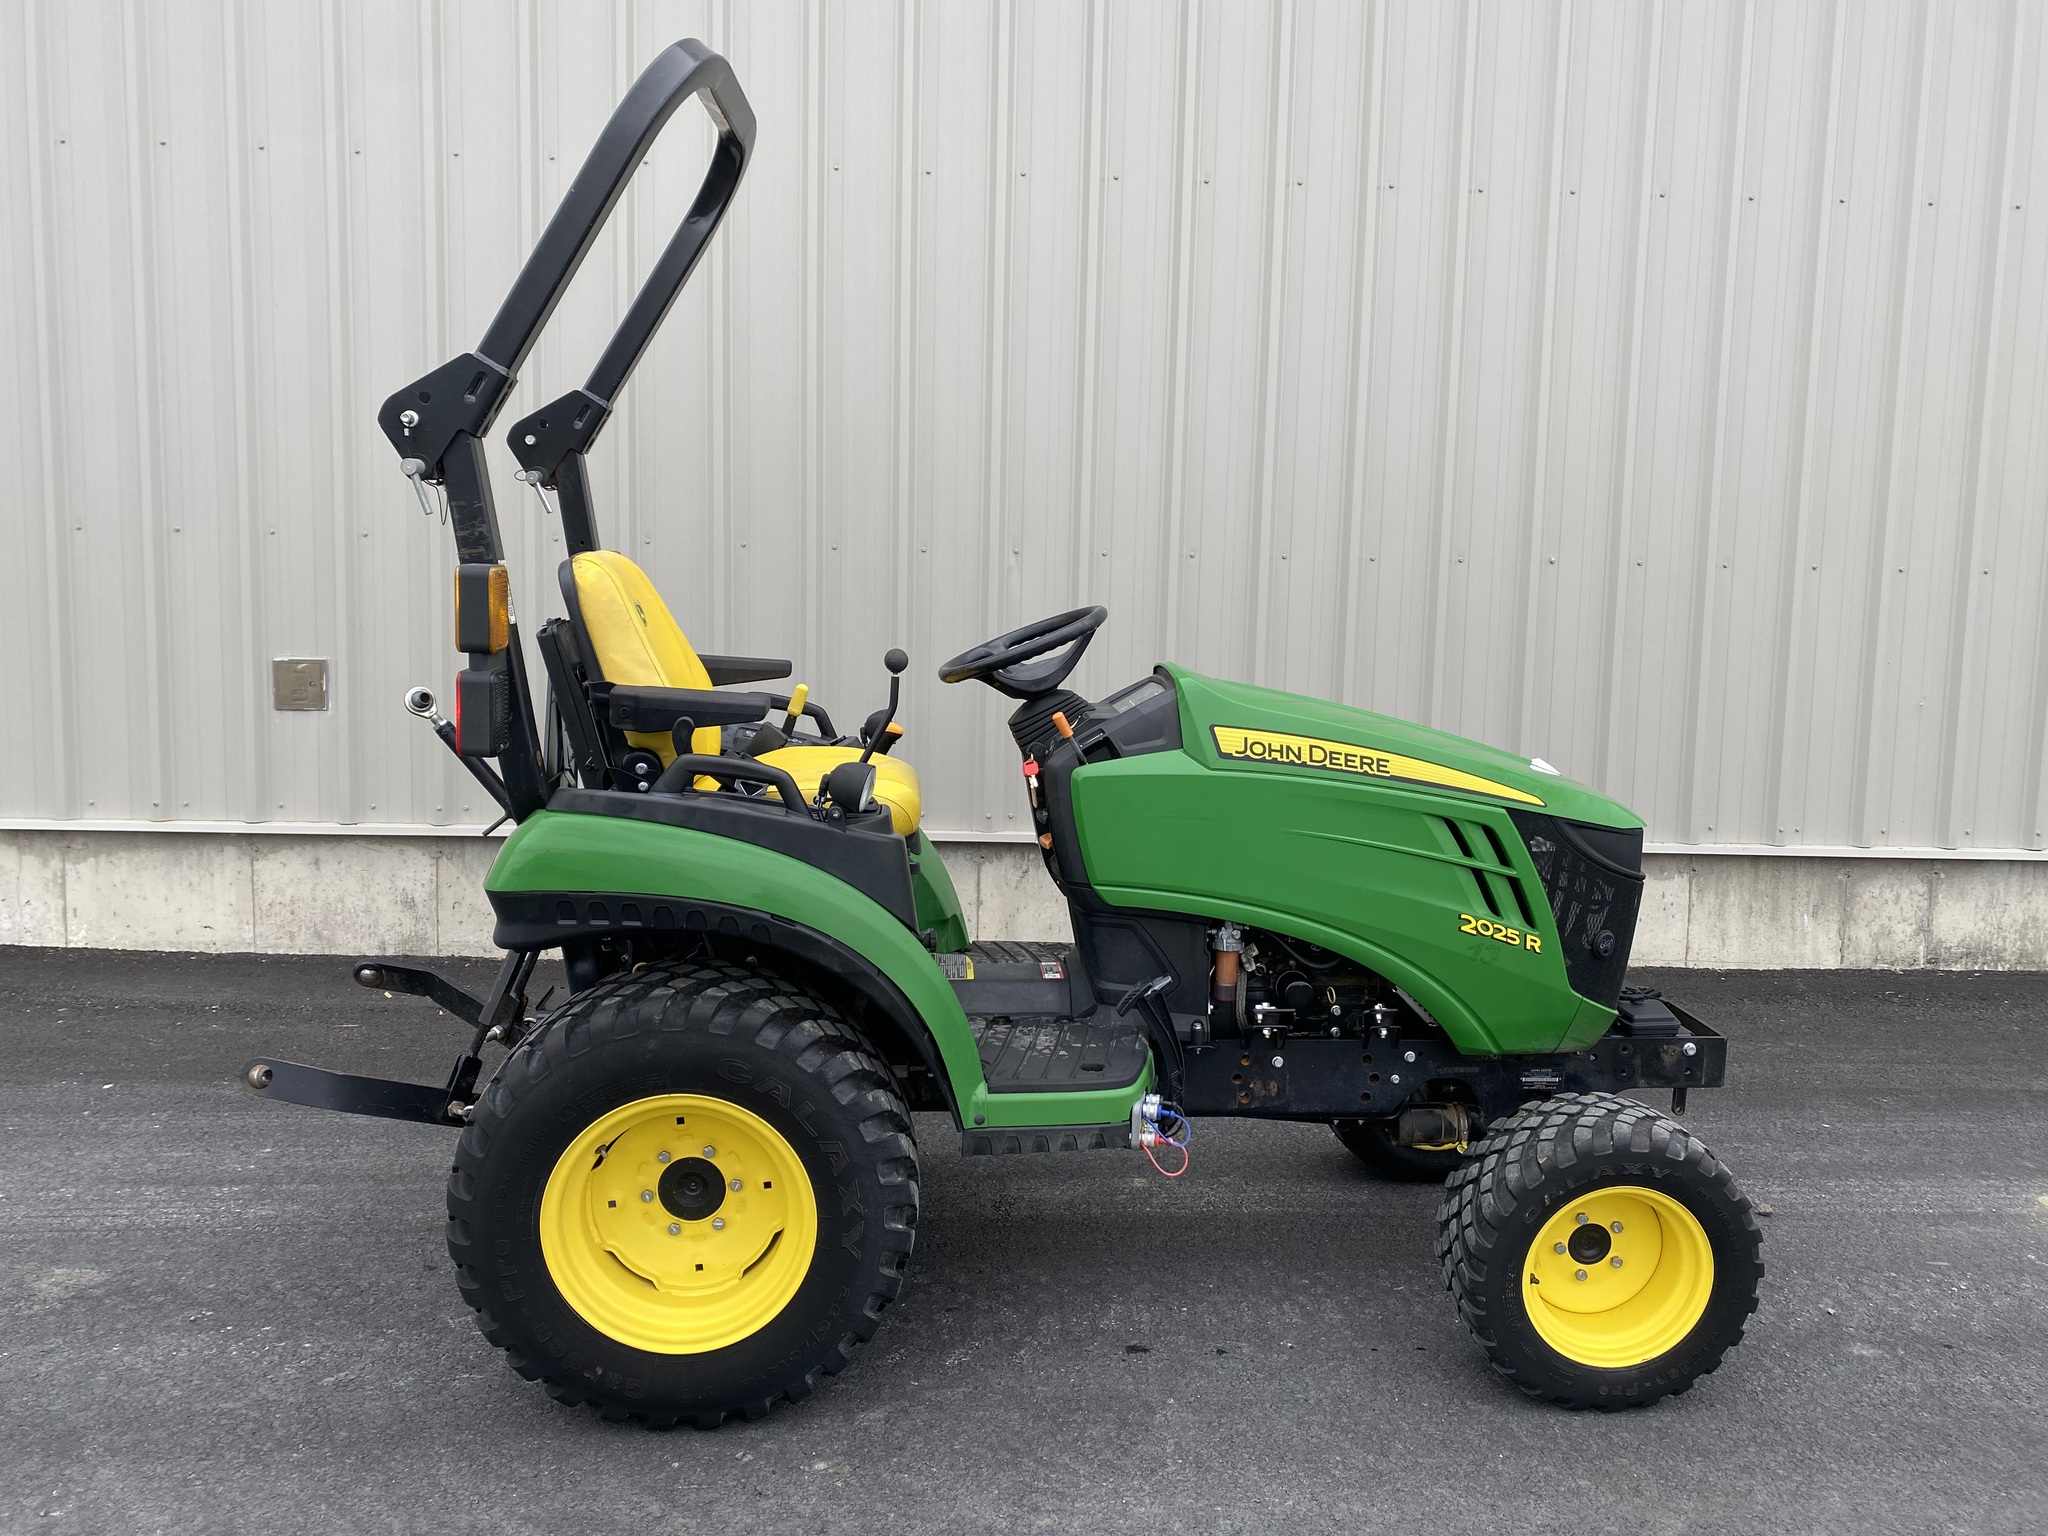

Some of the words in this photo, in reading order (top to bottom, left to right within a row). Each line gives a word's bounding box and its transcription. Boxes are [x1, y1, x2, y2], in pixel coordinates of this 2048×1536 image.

[1234, 736, 1302, 762] JOHN
[1308, 744, 1391, 774] DEERE
[1459, 913, 1521, 946] 2025
[1525, 933, 1542, 954] R
[716, 1057, 863, 1261] GALAXY
[1523, 1161, 1674, 1225] GALAXY
